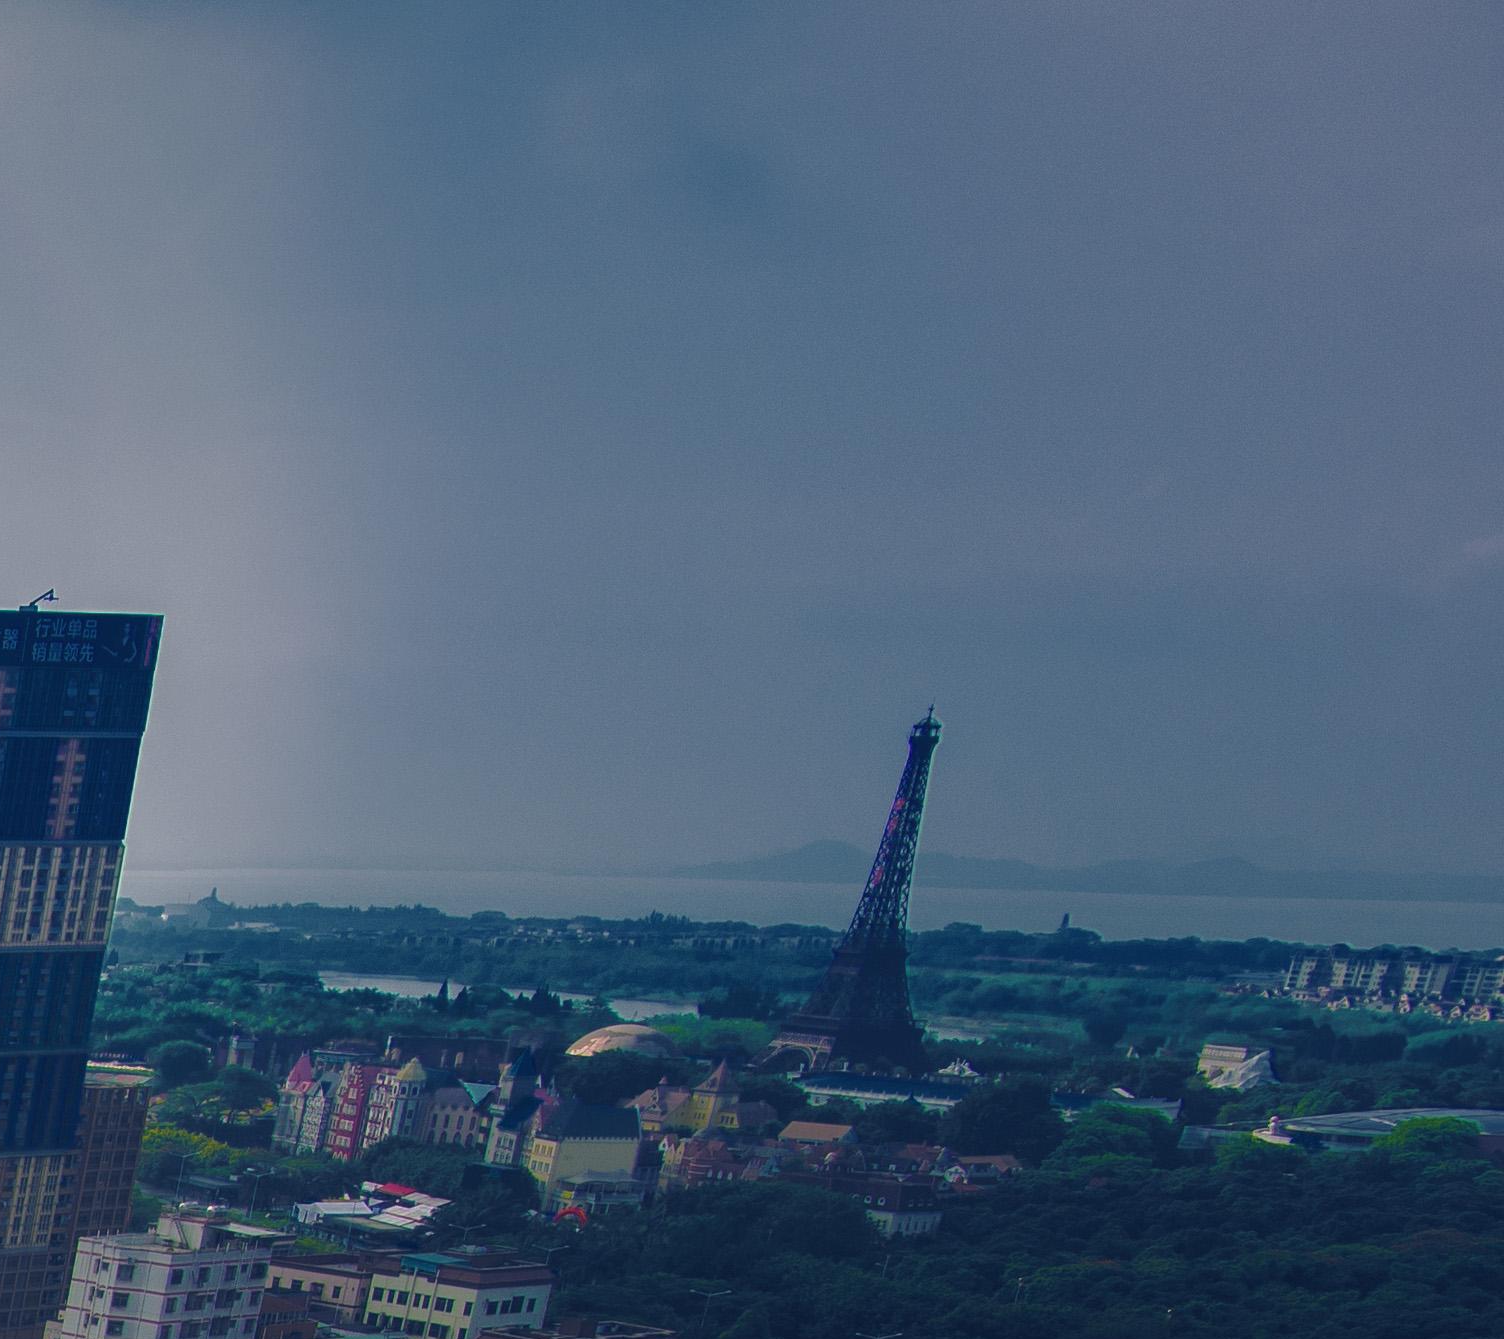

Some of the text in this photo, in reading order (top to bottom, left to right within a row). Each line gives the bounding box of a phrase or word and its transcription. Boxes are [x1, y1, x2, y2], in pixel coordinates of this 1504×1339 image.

[35, 617, 98, 639] 行业单品
[31, 641, 95, 662] 销量领先
